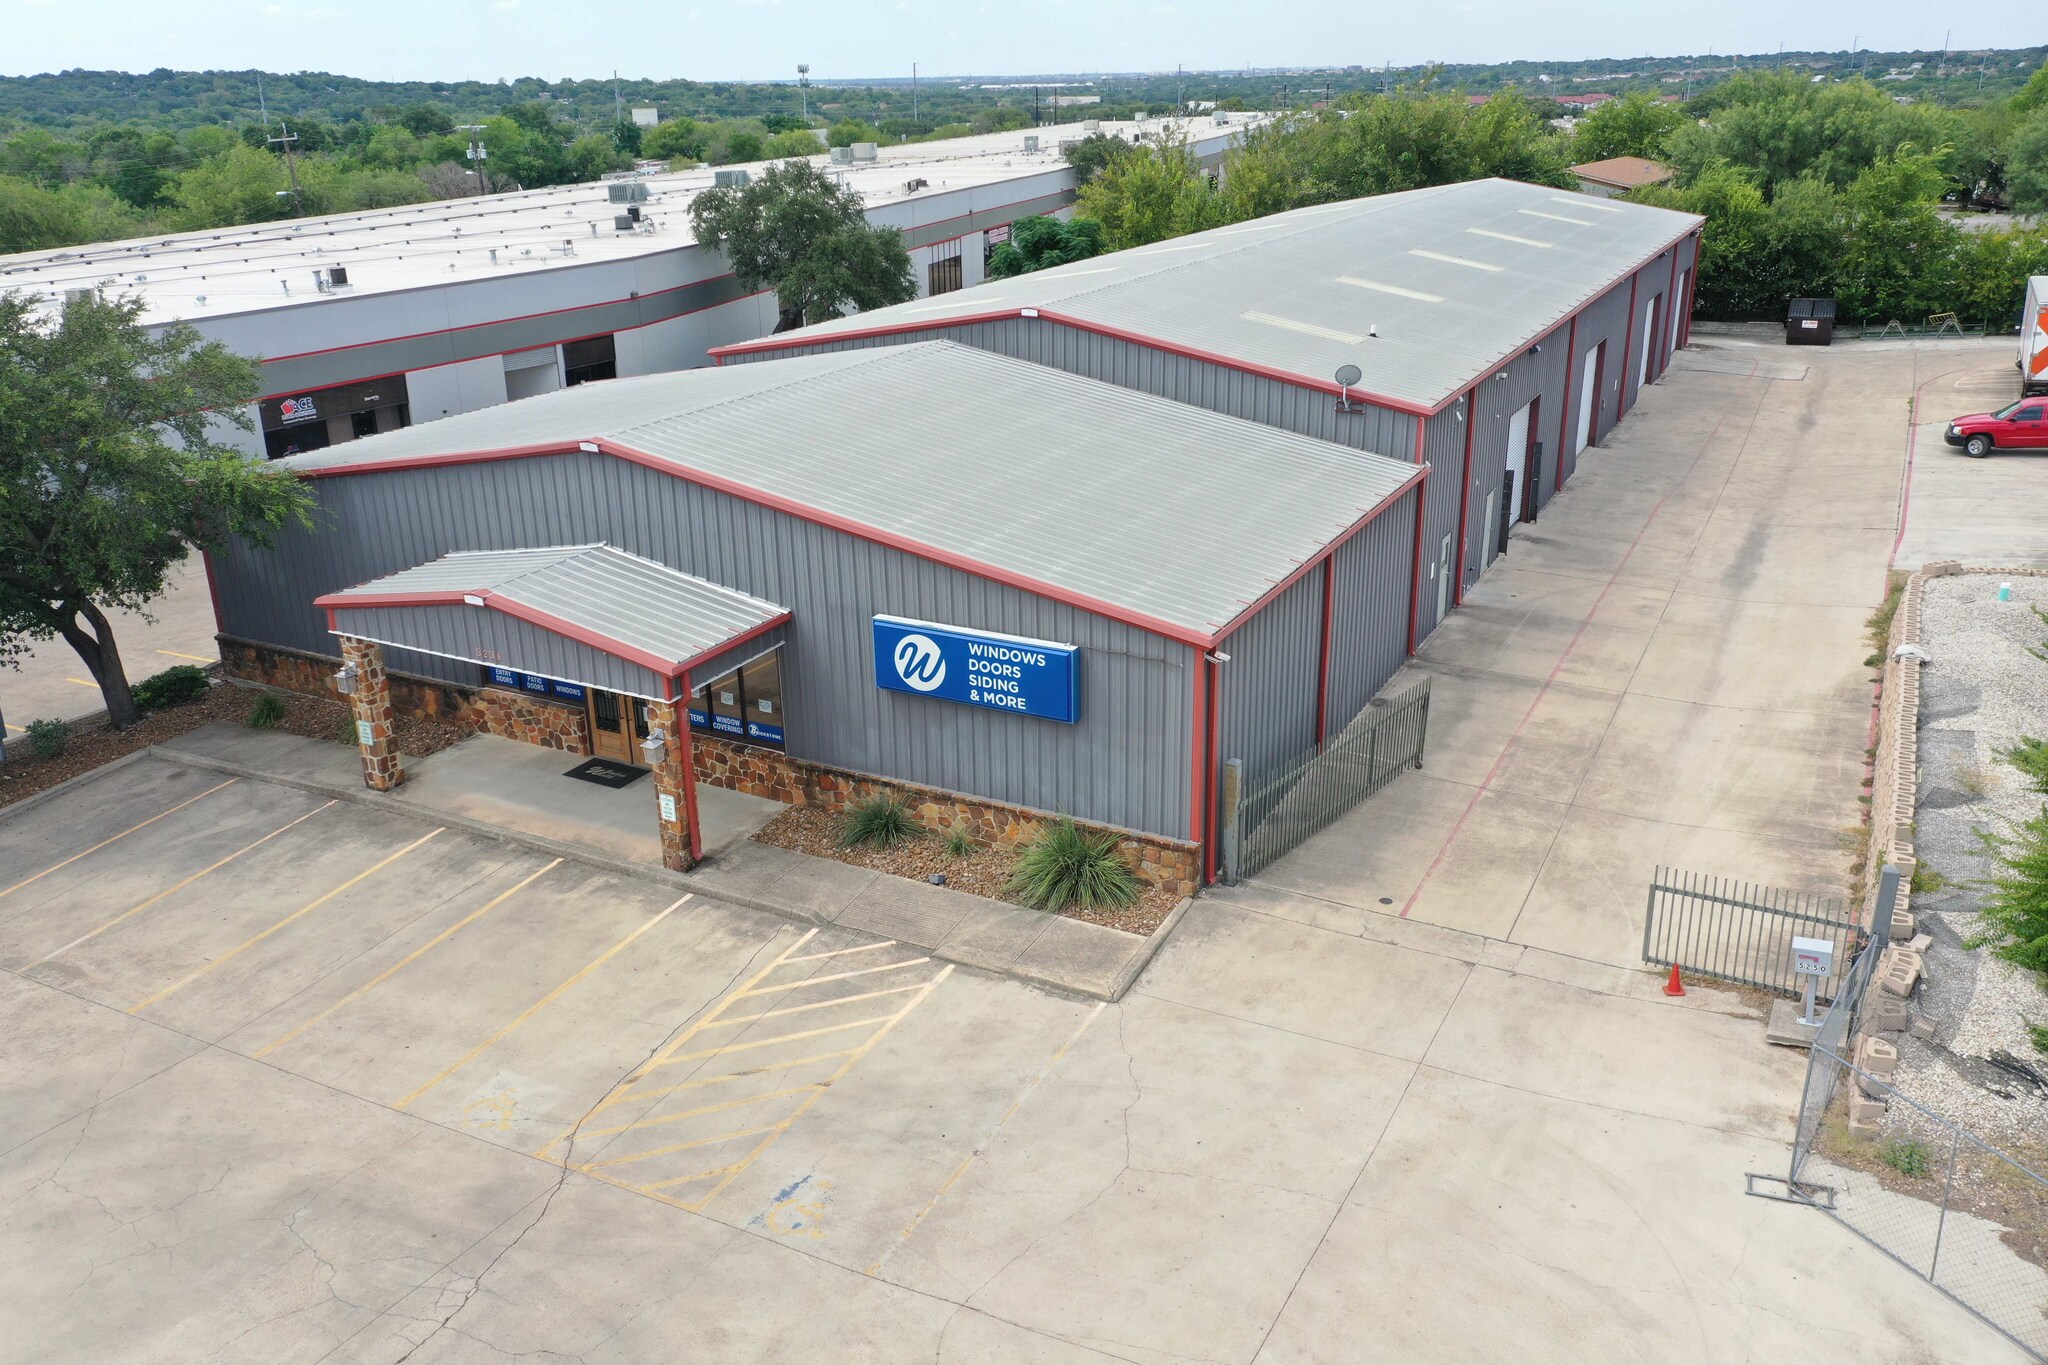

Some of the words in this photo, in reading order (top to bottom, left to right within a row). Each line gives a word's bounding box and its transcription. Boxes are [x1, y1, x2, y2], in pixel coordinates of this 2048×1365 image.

[290, 397, 313, 411] ACE
[968, 642, 1046, 667] WINDOWS
[495, 669, 511, 677] ENTRY
[968, 659, 1022, 679] DOORS
[495, 676, 512, 684] DOORS
[527, 675, 542, 685] PATIO
[968, 674, 1019, 693] SIDING
[527, 682, 544, 691] DOORS
[556, 686, 581, 696] WINDOWS
[970, 689, 980, 702] &
[983, 692, 1027, 710] MORE
[689, 713, 705, 723] TERS
[716, 716, 740, 725] WINDOW
[713, 722, 743, 734] COVERINGS
[1799, 963, 1826, 972] 5250
